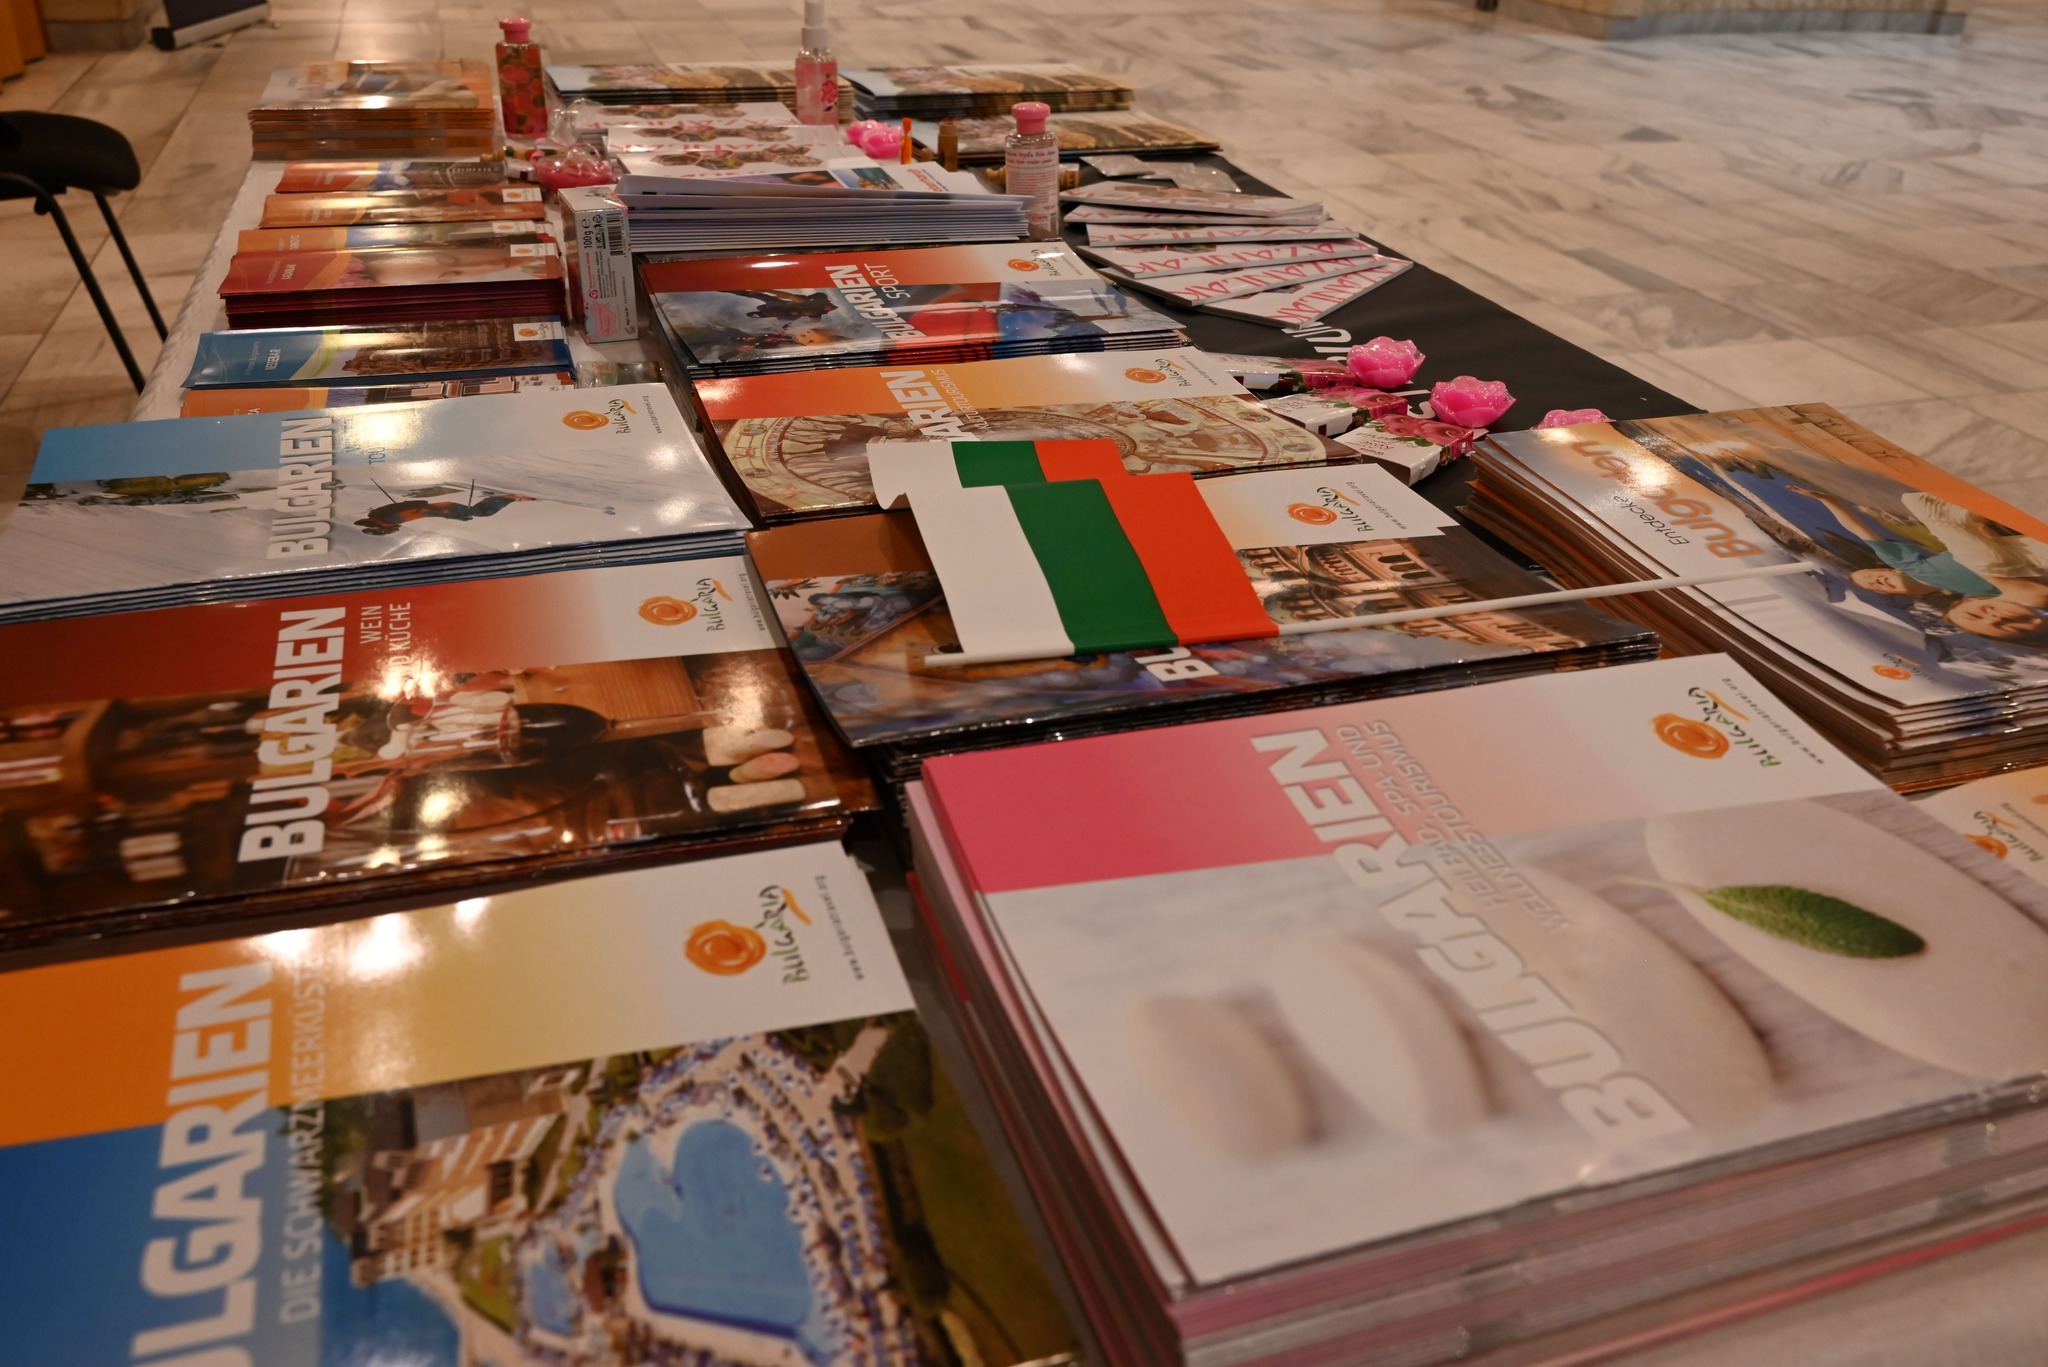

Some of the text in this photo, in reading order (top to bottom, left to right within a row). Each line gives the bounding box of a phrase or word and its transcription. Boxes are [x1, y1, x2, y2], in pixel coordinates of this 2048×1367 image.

[824, 264, 927, 340] BULGARIEN
[863, 263, 911, 298] SPORT
[266, 416, 333, 560] BULGARIEN
[1571, 440, 1763, 559] Bulgaien
[1613, 495, 1691, 546] Entdecke
[360, 605, 382, 644] WEIN
[384, 602, 411, 651] KÜCHE
[237, 606, 347, 863] BULGARIEN
[1335, 724, 1383, 770] UND
[1363, 719, 1573, 934] WELLNESSTOURISMUS
[1250, 727, 1696, 1145] BULGARIEN
[279, 1262, 322, 1324] DIE
